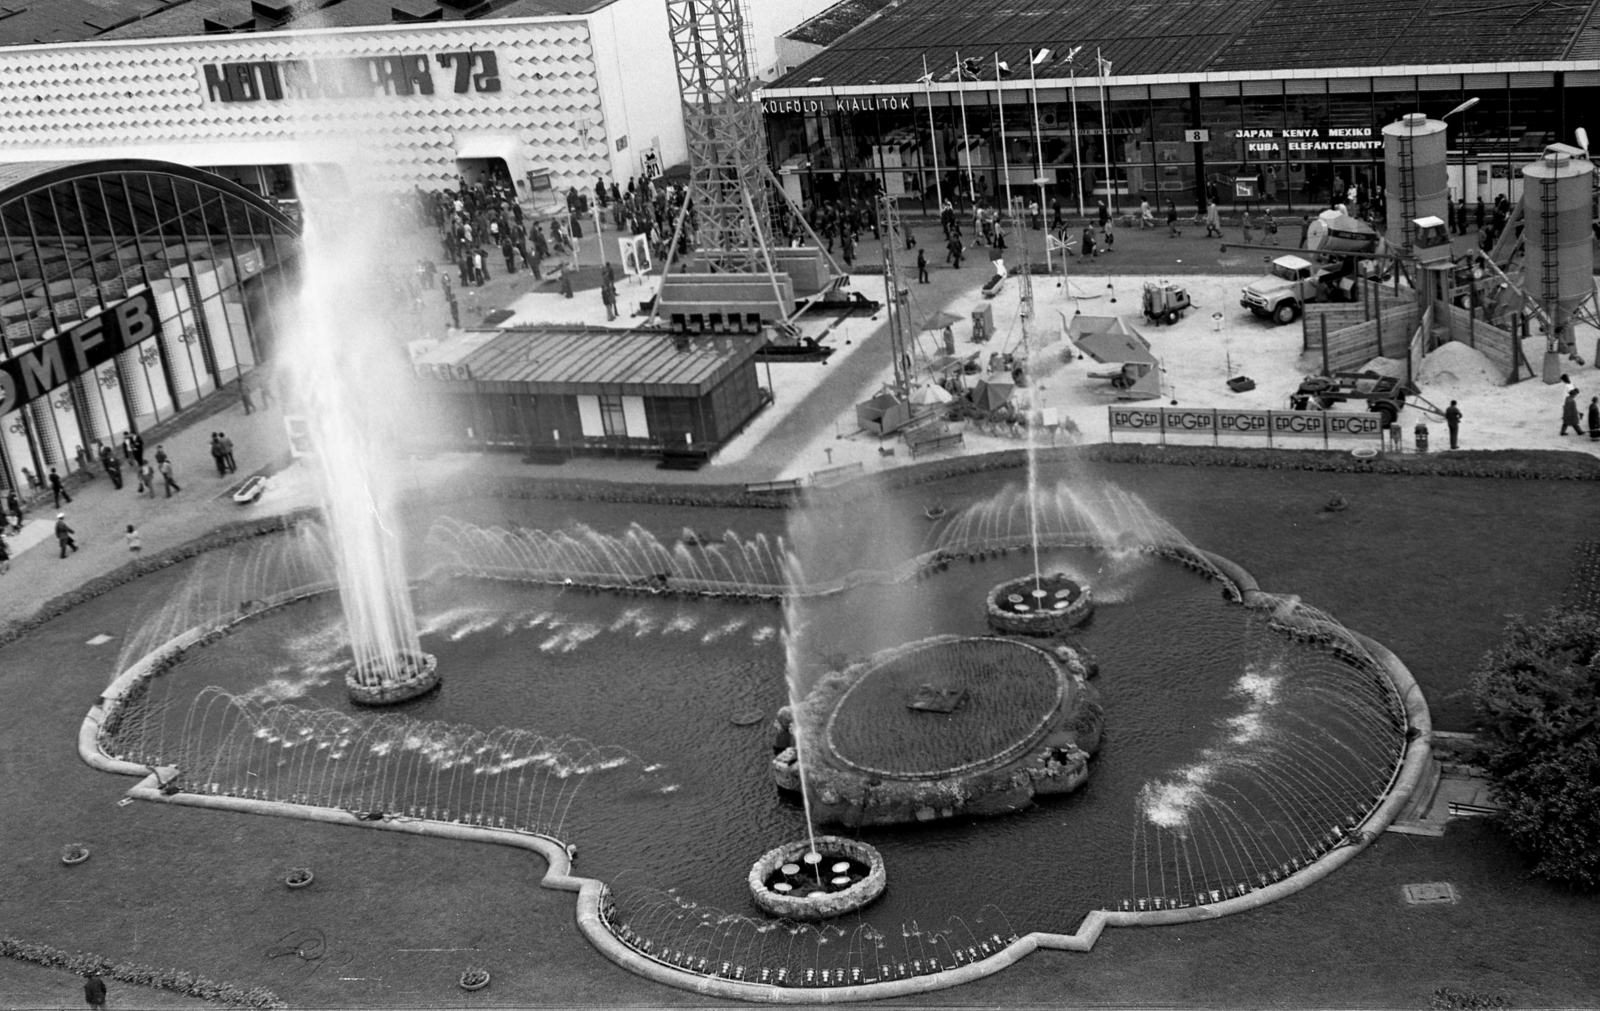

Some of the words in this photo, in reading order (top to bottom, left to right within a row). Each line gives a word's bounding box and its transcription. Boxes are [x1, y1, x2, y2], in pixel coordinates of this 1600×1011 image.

[760, 100, 824, 114] KÜLFÖLDI
[1193, 131, 1201, 140] 8
[1235, 129, 1273, 138] JAPÁN
[1282, 129, 1319, 137] KENYA
[1328, 128, 1372, 137] MEXIKO
[1248, 142, 1280, 151] KUBA
